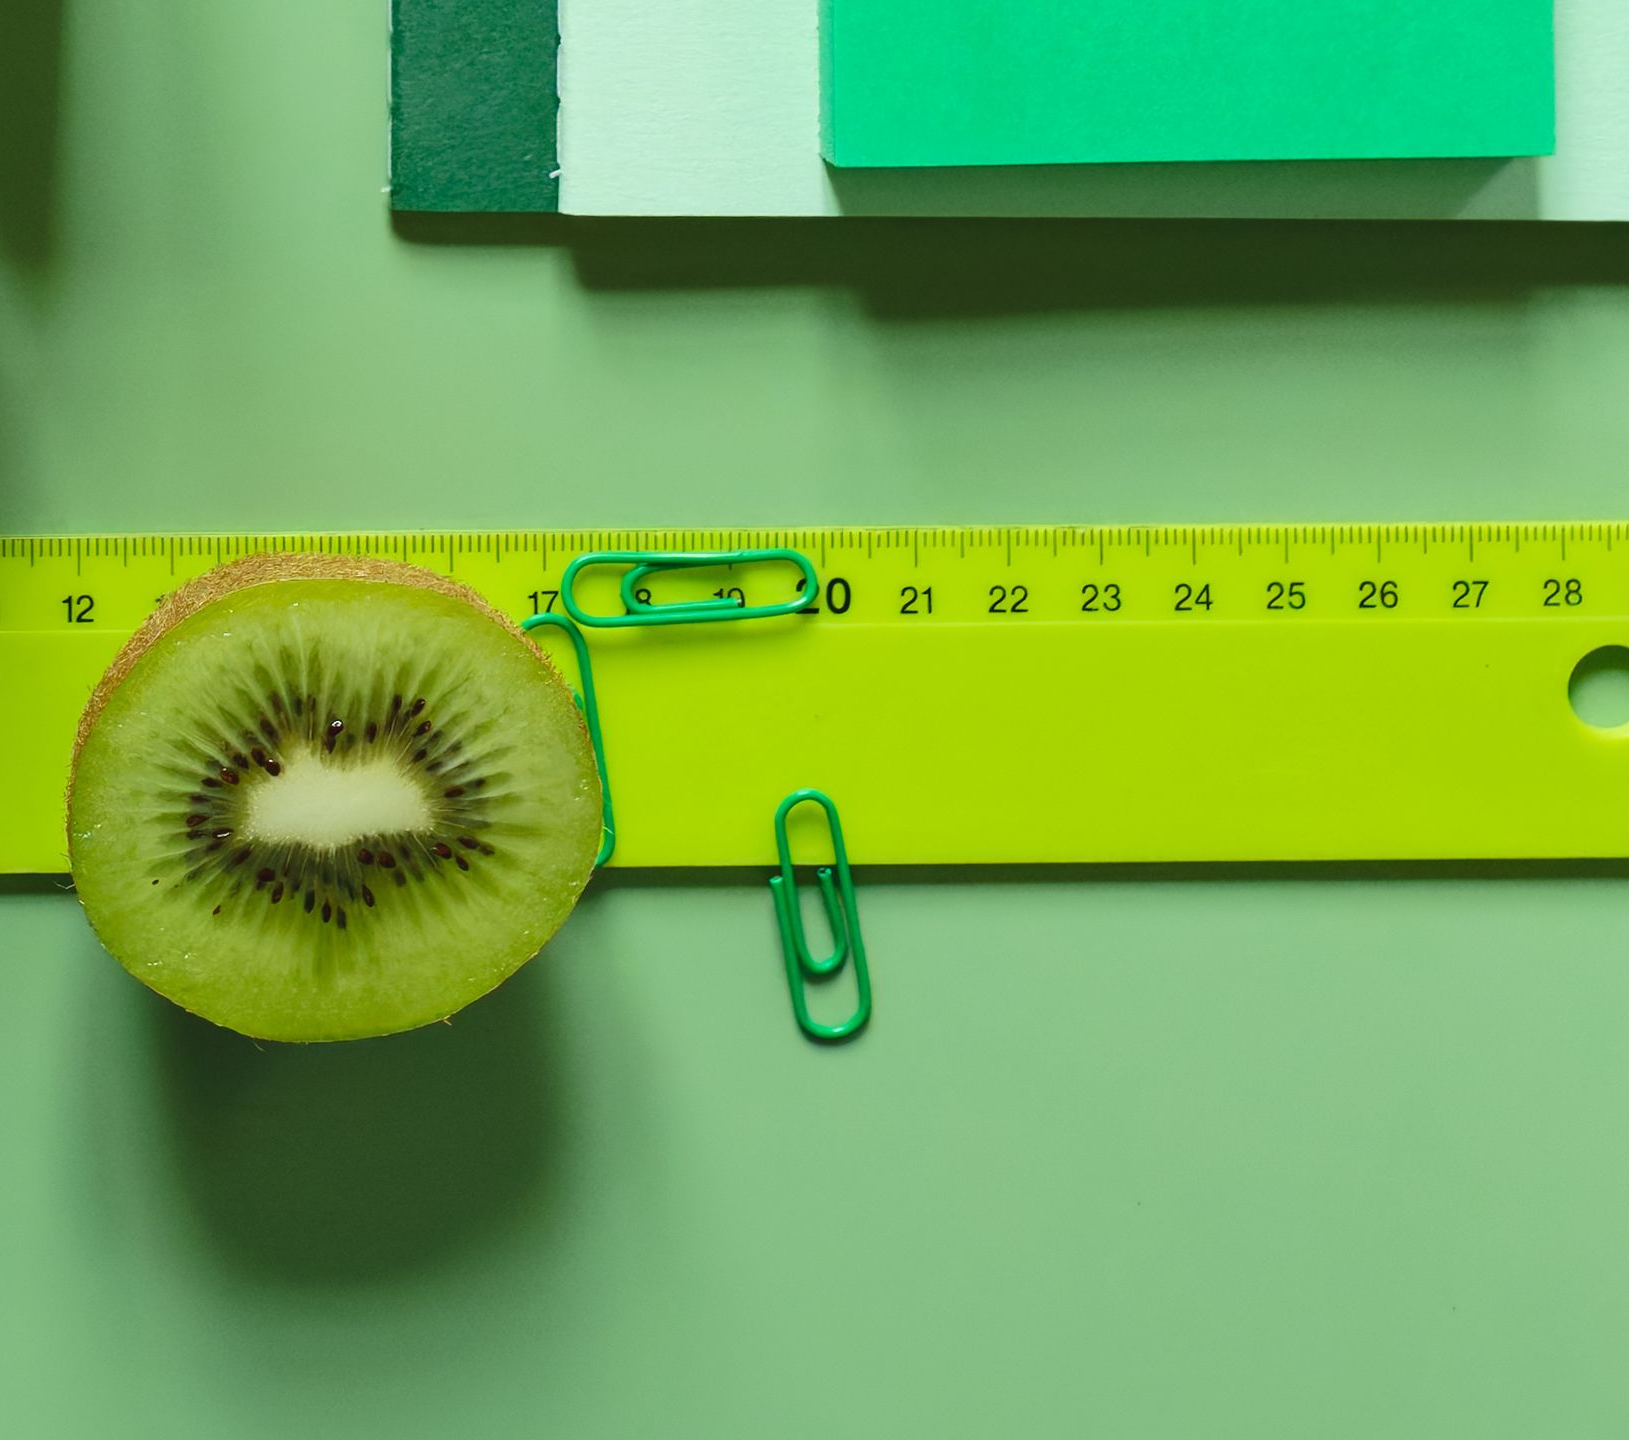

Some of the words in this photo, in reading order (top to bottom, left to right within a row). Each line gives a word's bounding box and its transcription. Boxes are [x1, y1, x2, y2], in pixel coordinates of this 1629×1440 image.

[62, 594, 95, 623] 12
[527, 590, 559, 615] 17
[900, 586, 932, 615] 21
[988, 585, 1029, 613] 22
[1081, 583, 1121, 612] 23
[1174, 583, 1213, 612] 24
[1266, 581, 1306, 610] 25
[1358, 580, 1399, 609] 26
[1452, 580, 1489, 608] 27
[1543, 578, 1583, 607] 28
